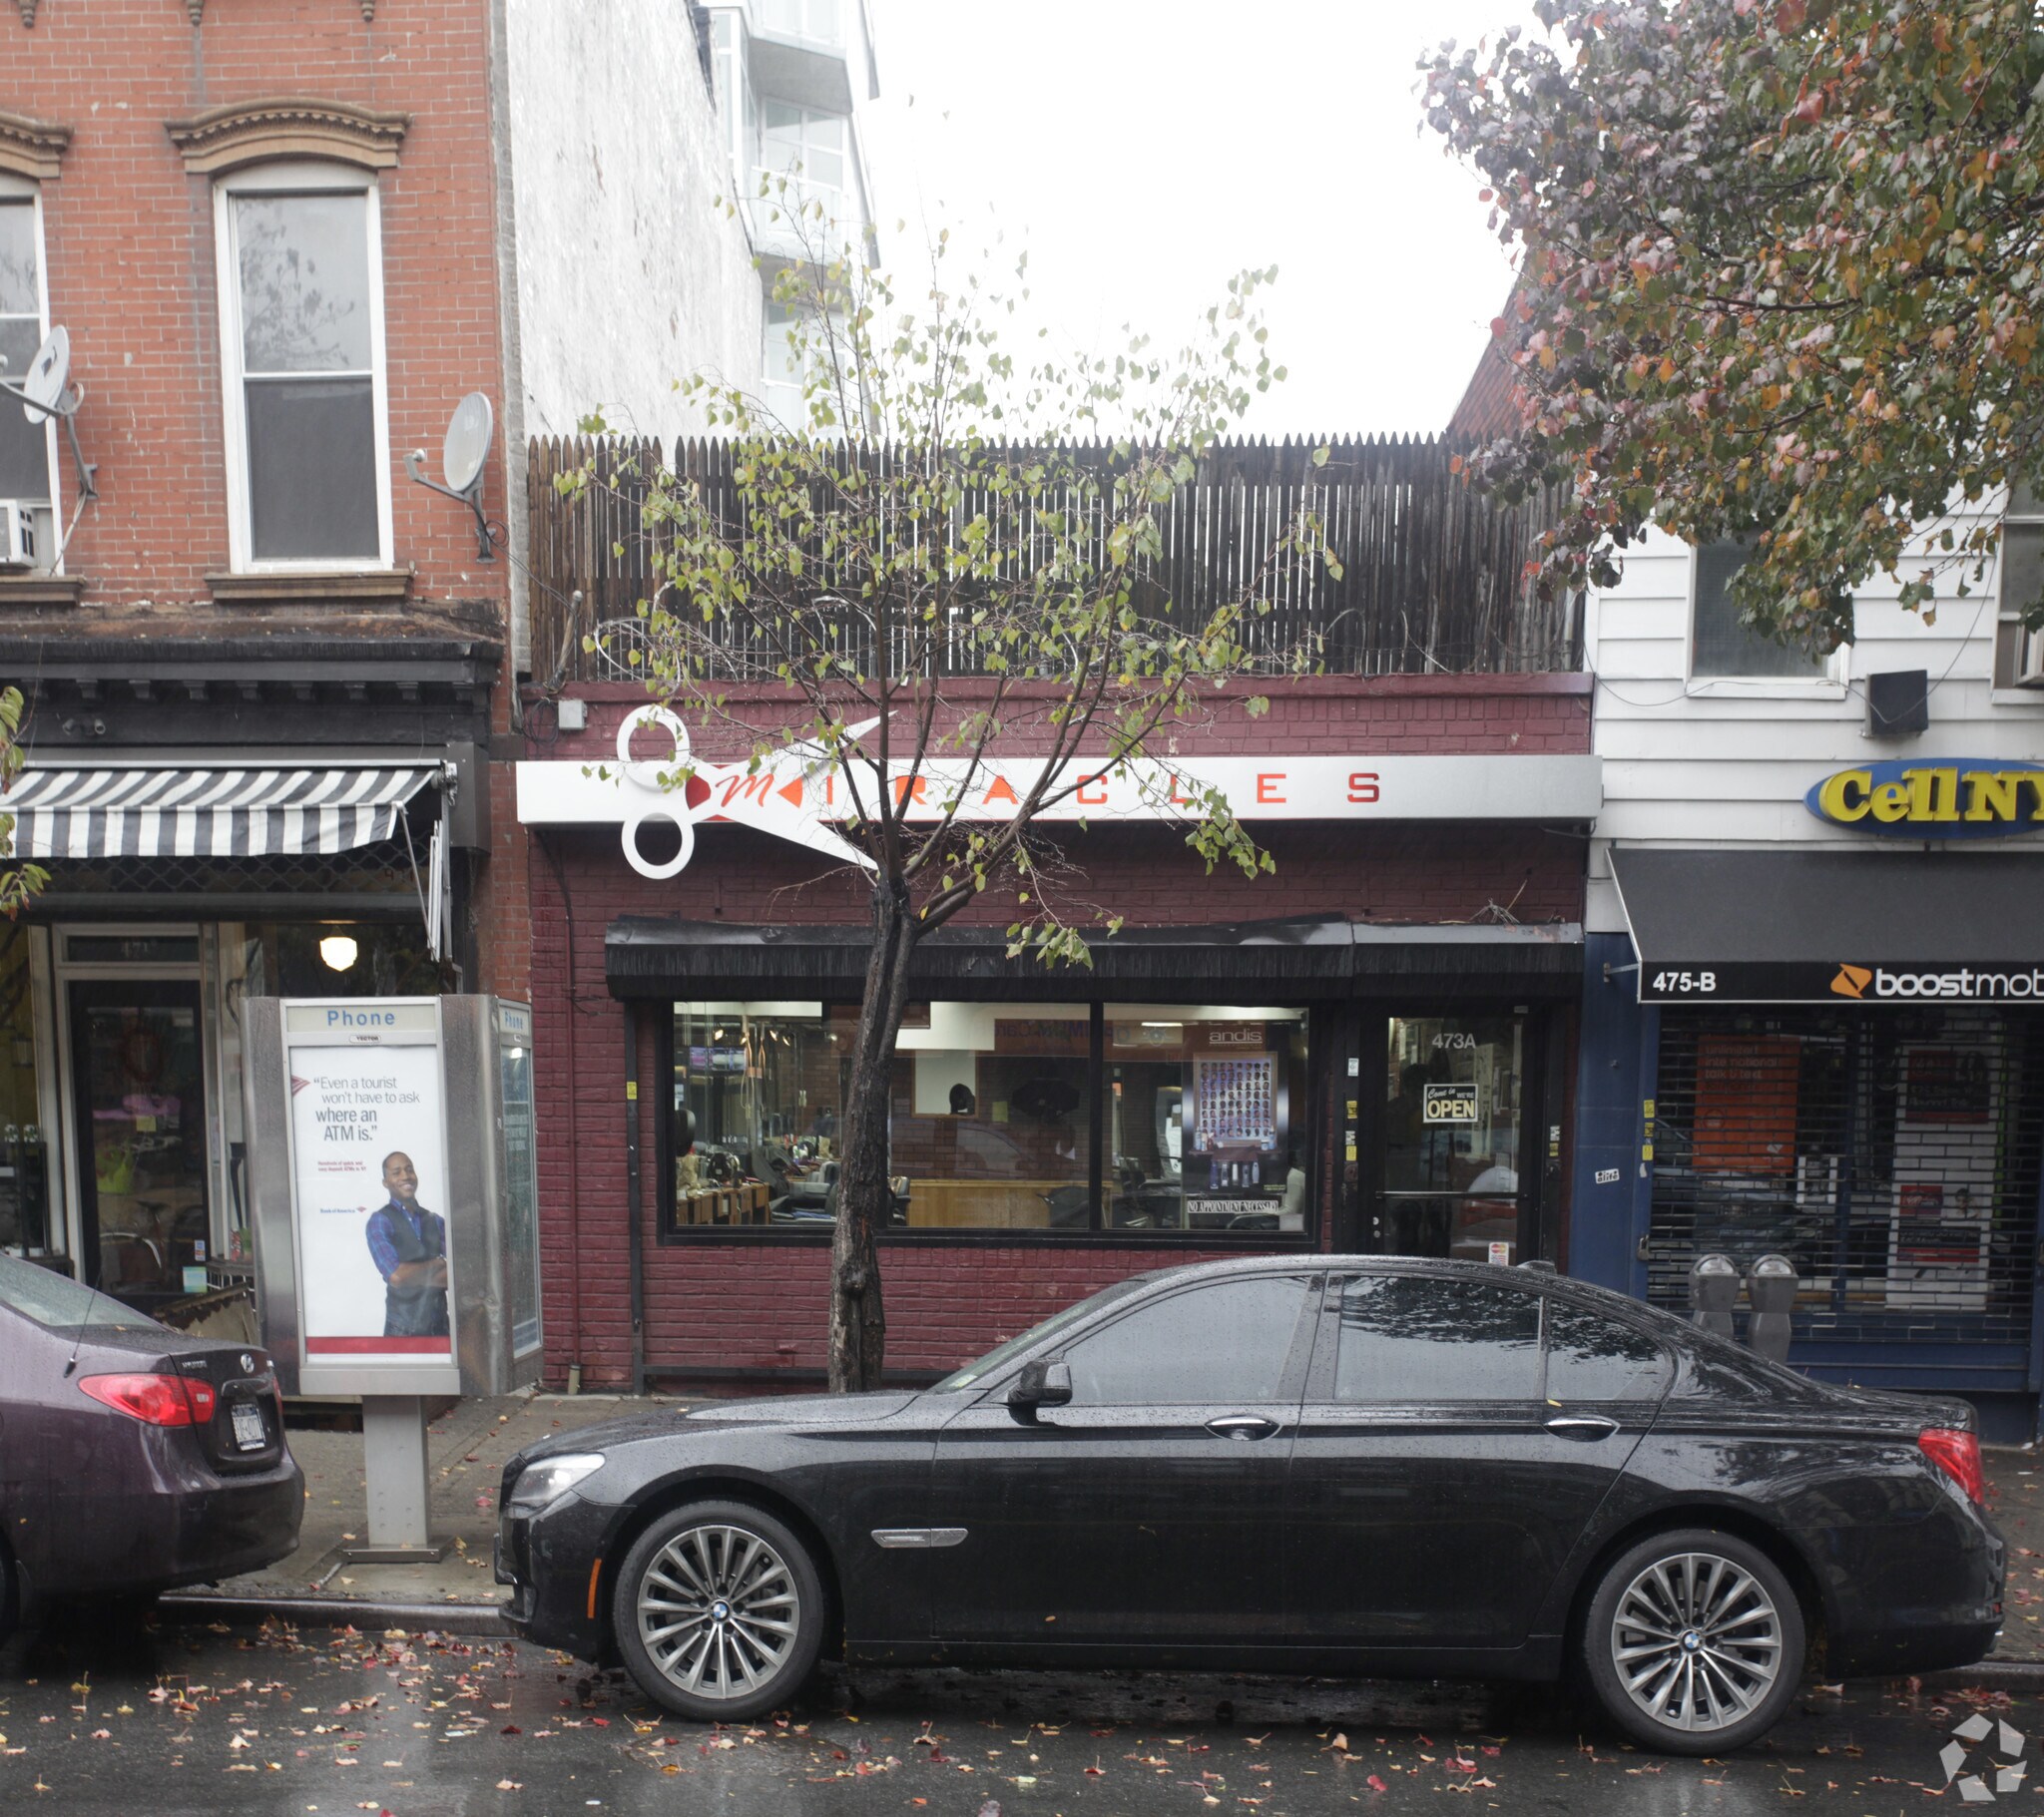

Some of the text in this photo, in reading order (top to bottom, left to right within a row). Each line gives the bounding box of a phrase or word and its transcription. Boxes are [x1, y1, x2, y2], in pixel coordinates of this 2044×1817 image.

[1653, 972, 1717, 992] 475-B
[327, 1010, 395, 1026] Phone
[1209, 1028, 1263, 1042] andis
[1431, 1033, 1477, 1049] 473A
[351, 1079, 358, 1089] a
[361, 1077, 397, 1089] tourist
[321, 1092, 420, 1104] won't have to ask
[1427, 1088, 1447, 1100] Come
[315, 1107, 377, 1123] where an
[1427, 1100, 1475, 1118] OPEN
[323, 1126, 354, 1140] ATM
